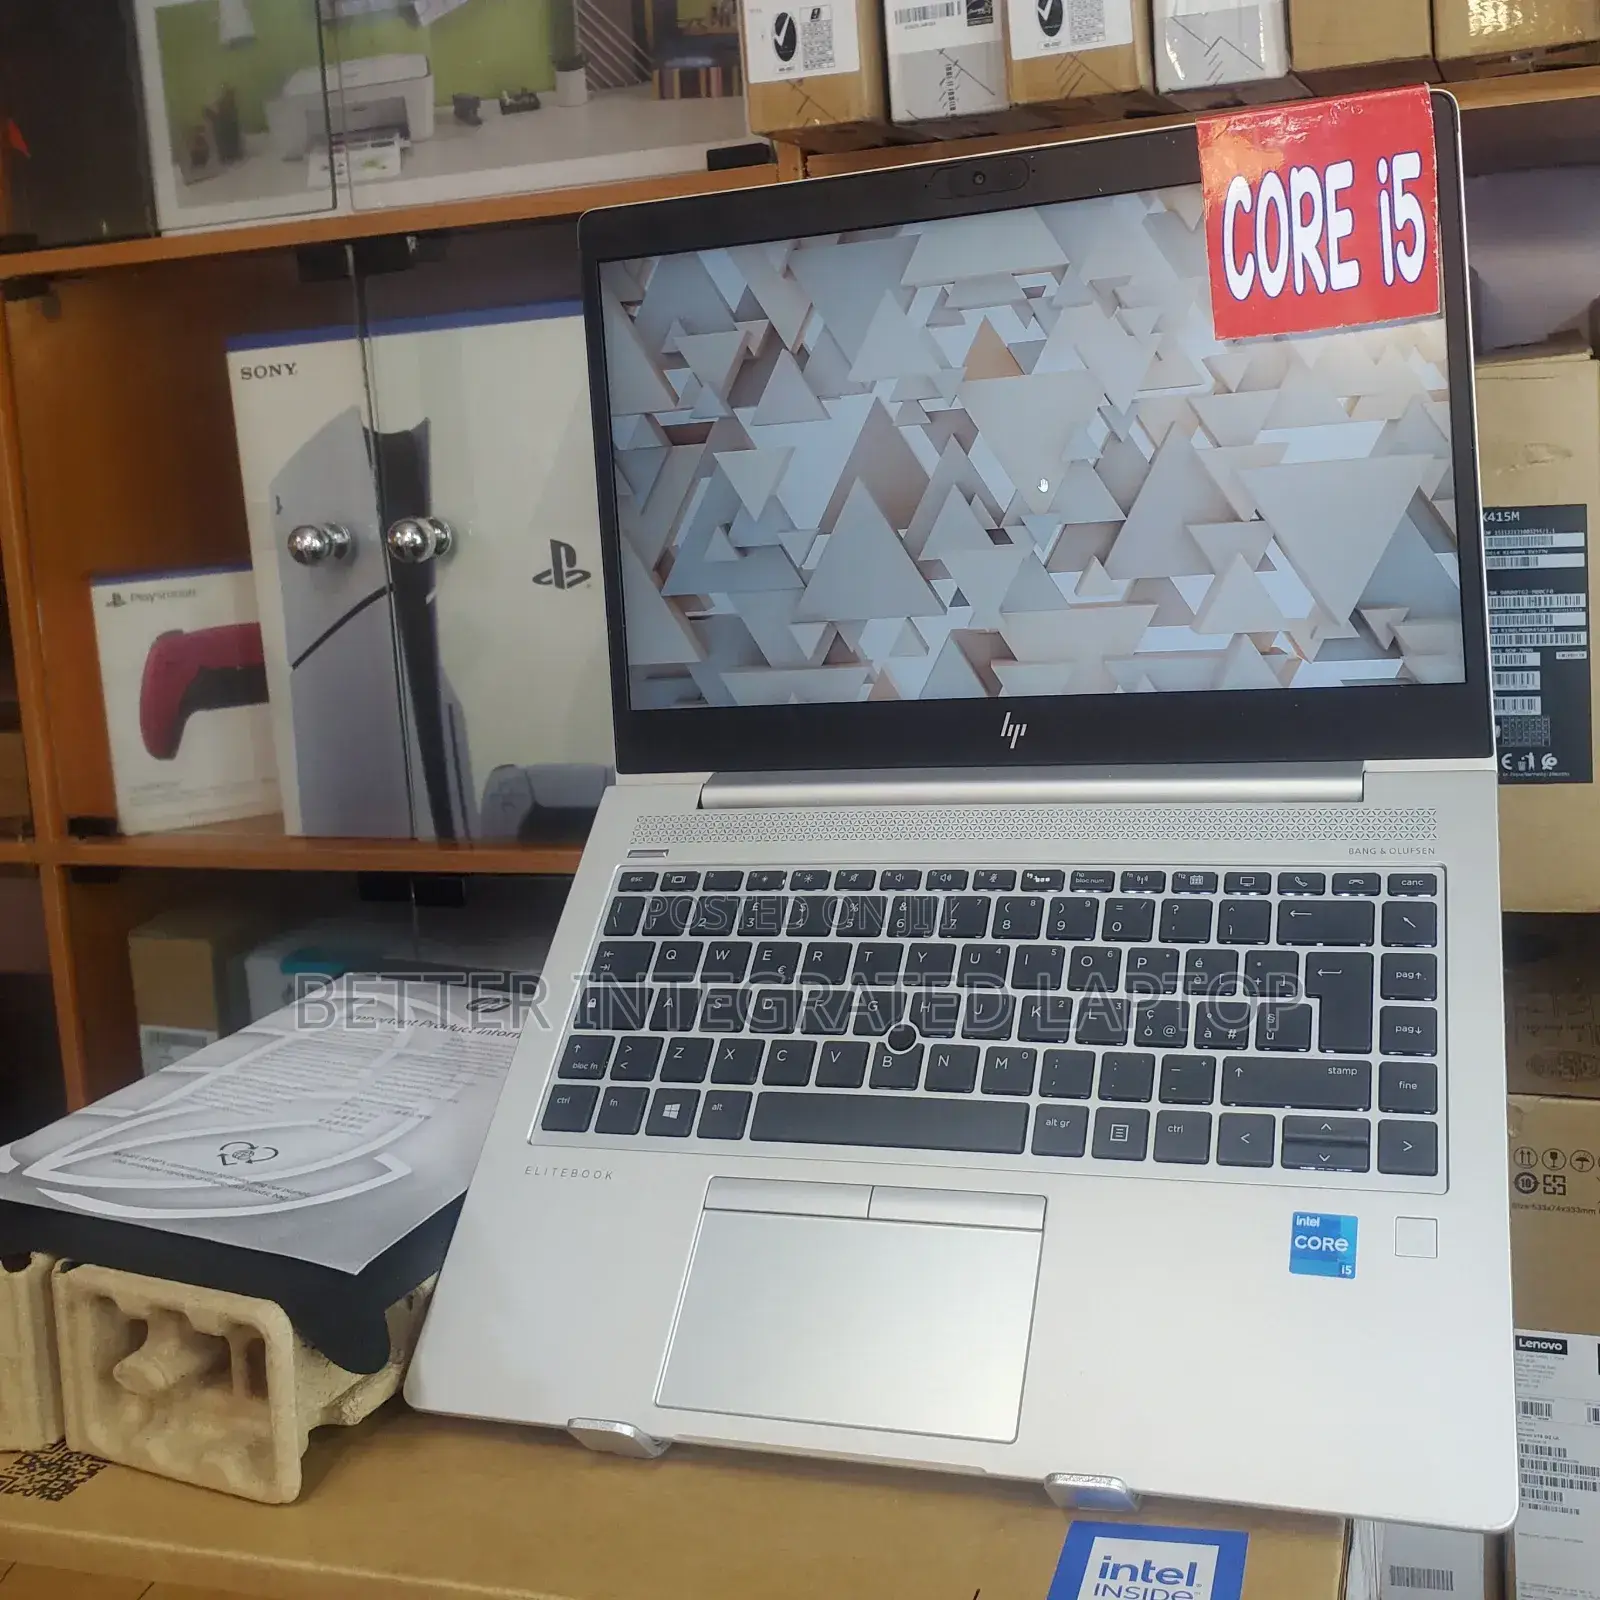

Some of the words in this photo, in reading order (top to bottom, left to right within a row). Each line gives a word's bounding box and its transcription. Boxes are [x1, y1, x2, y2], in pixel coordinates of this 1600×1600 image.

[1222, 159, 1362, 301] CORE
[1376, 150, 1427, 287] i5
[241, 362, 297, 380] SONY
[1000, 711, 1028, 749] hp
[1348, 847, 1377, 855] BANG
[1389, 847, 1435, 855] OLUFSEN
[849, 902, 859, 912] %
[899, 901, 907, 911] &
[1029, 899, 1036, 907] 8
[1171, 904, 1179, 916] ?
[698, 918, 707, 927] 2
[746, 917, 755, 927] 3
[796, 918, 804, 928] 4
[846, 918, 854, 927] 5
[896, 918, 904, 928] 6
[950, 919, 958, 928] 7
[1001, 919, 1011, 930] 8
[1056, 920, 1066, 932] 9
[665, 950, 677, 961] Q
[715, 950, 731, 961] W
[762, 950, 772, 961] E
[812, 951, 823, 962] R
[864, 951, 874, 962] T
[917, 952, 927, 963] Y
[970, 953, 981, 964] U
[1107, 950, 1114, 958] 6
[1081, 956, 1093, 967] O
[1137, 958, 1147, 969] P
[1195, 958, 1203, 968] é
[777, 964, 787, 975] €
[1396, 970, 1414, 980] pag
[663, 998, 674, 1009] A
[713, 998, 723, 1009] S
[762, 999, 774, 1010] D
[867, 1001, 879, 1012] G
[920, 1002, 931, 1013] H
[1058, 1000, 1065, 1008] 2
[1115, 1002, 1122, 1010] 3
[975, 1004, 983, 1015] J
[1031, 1006, 1042, 1017] K
[1088, 1008, 1097, 1020] L
[419, 1018, 476, 1034] Product
[1144, 1026, 1153, 1036] ò
[1162, 1025, 1177, 1037] @
[1395, 1025, 1413, 1035] pag
[1204, 1028, 1212, 1039] à
[1227, 1029, 1237, 1039] #
[673, 1047, 685, 1059] Z
[724, 1048, 735, 1060] X
[777, 1050, 788, 1062] C
[831, 1051, 842, 1063] V
[572, 1062, 588, 1070] bloc
[589, 1062, 598, 1071] fn
[882, 1056, 893, 1067] B
[938, 1055, 950, 1067] N
[995, 1057, 1009, 1070] M
[1327, 1067, 1358, 1076] stamp
[1398, 1081, 1418, 1091] fine
[556, 1097, 570, 1105] ctrl
[609, 1098, 619, 1108] fn
[711, 1103, 723, 1111] alt
[1045, 1118, 1058, 1127] alt
[1059, 1119, 1071, 1128] gr
[1167, 1124, 1184, 1134] ctrl
[524, 1165, 613, 1180] ELITEBOOK
[1296, 1215, 1320, 1228] intel
[1341, 1264, 1352, 1275] i5
[1519, 1338, 1563, 1351] Lenovo
[1098, 1555, 1198, 1587] intel
